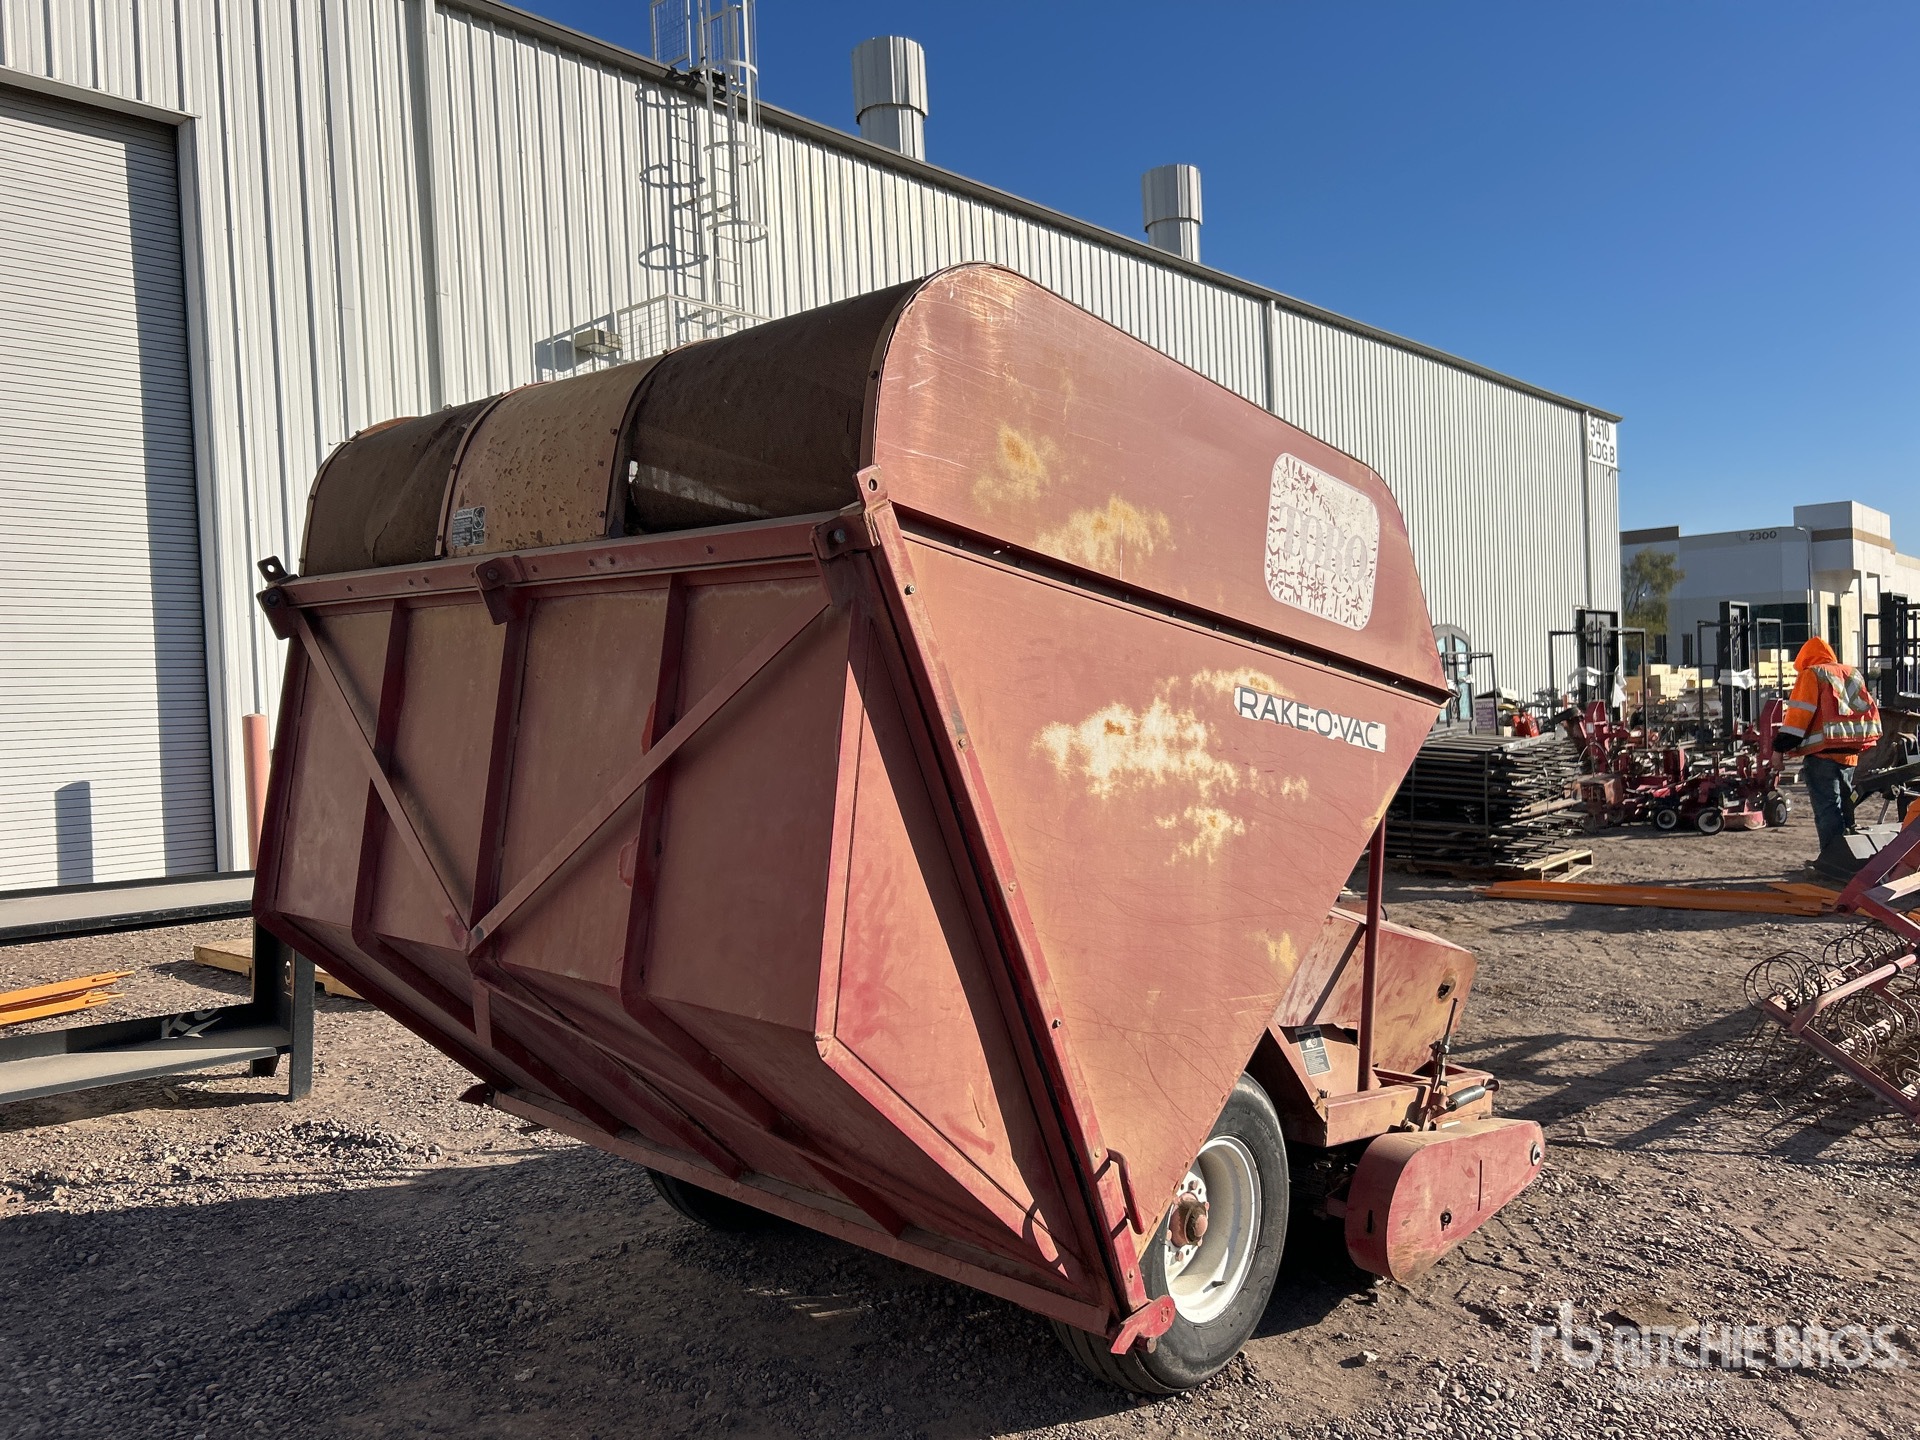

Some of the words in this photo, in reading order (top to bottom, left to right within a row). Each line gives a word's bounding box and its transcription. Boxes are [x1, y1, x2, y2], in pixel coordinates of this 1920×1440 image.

[1590, 416, 1610, 442] 5410
[1609, 445, 1616, 464] B
[1279, 501, 1368, 583] TORO
[1749, 530, 1777, 541] 2300
